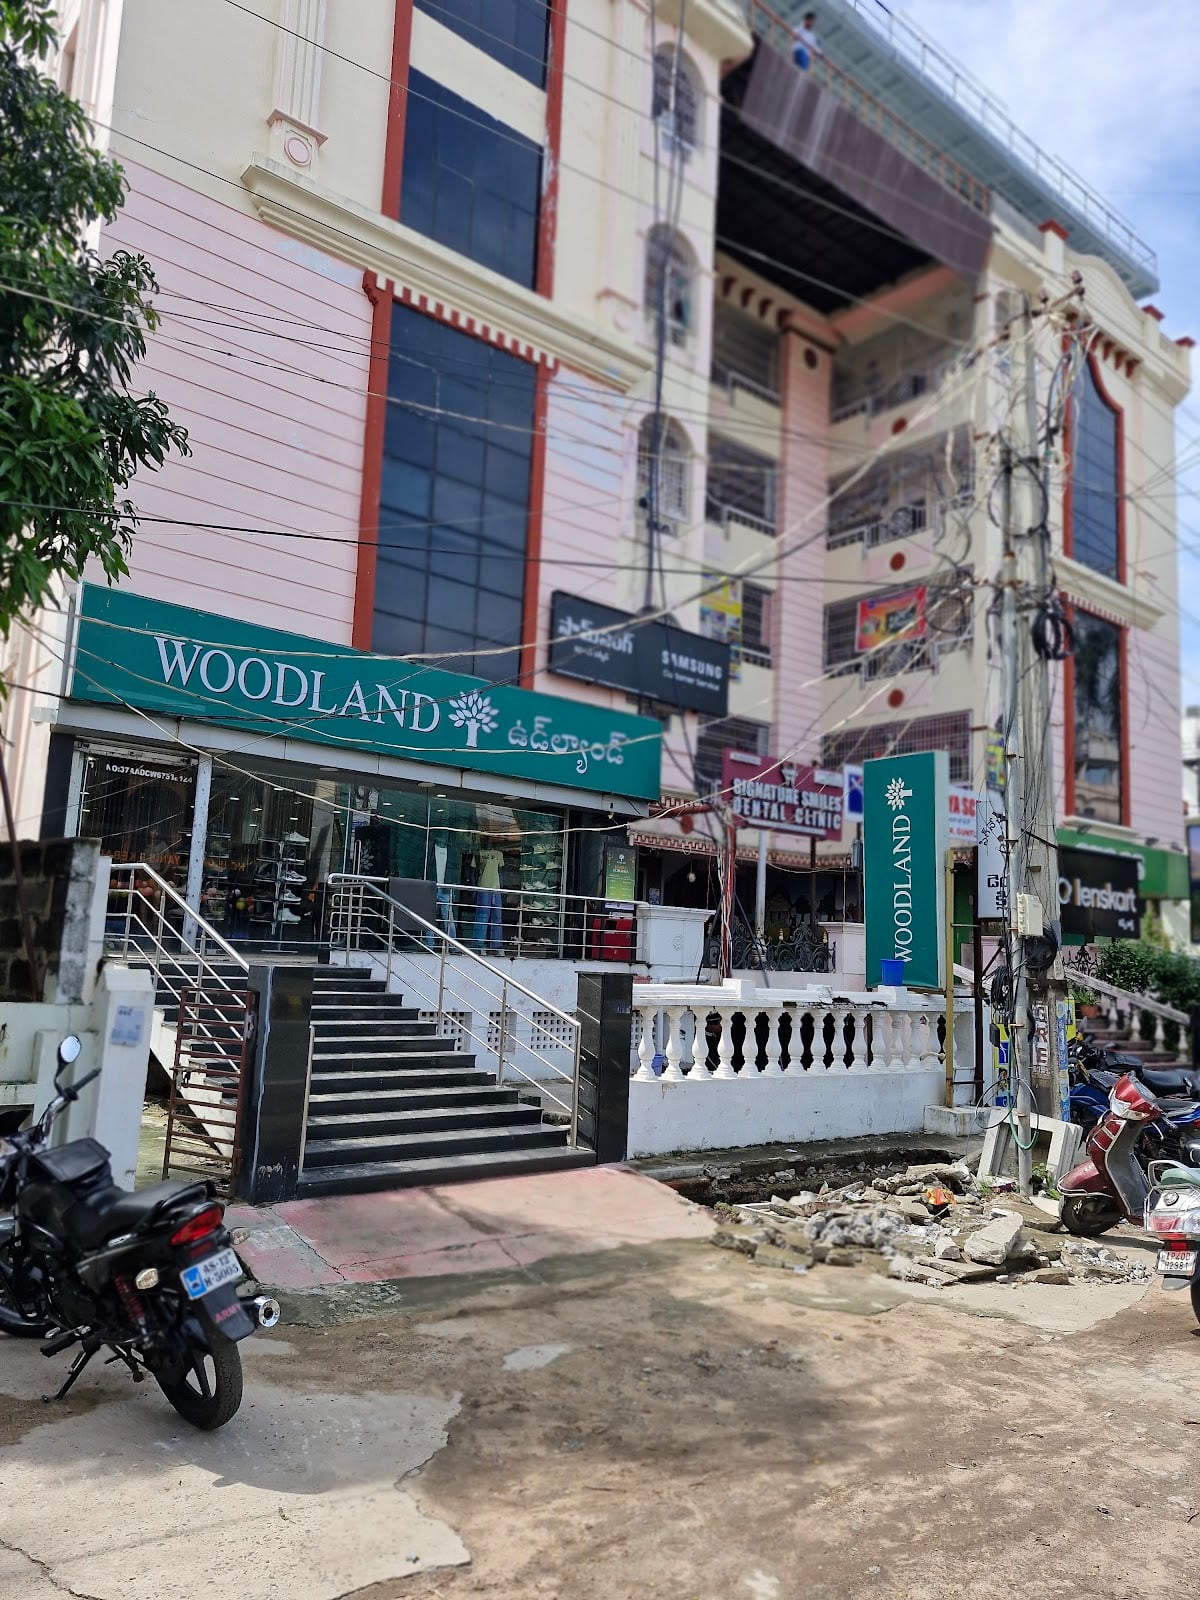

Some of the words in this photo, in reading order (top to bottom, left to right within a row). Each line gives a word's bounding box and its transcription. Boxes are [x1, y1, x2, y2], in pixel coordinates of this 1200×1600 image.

[153, 636, 440, 733] WOODLAND
[732, 777, 800, 805] SIGNATURE
[801, 790, 842, 812] SMILES
[732, 796, 787, 821] DENTAL
[794, 807, 842, 829] CLINIC
[892, 814, 913, 963] WOODLAND
[1073, 878, 1137, 913] lenskart
